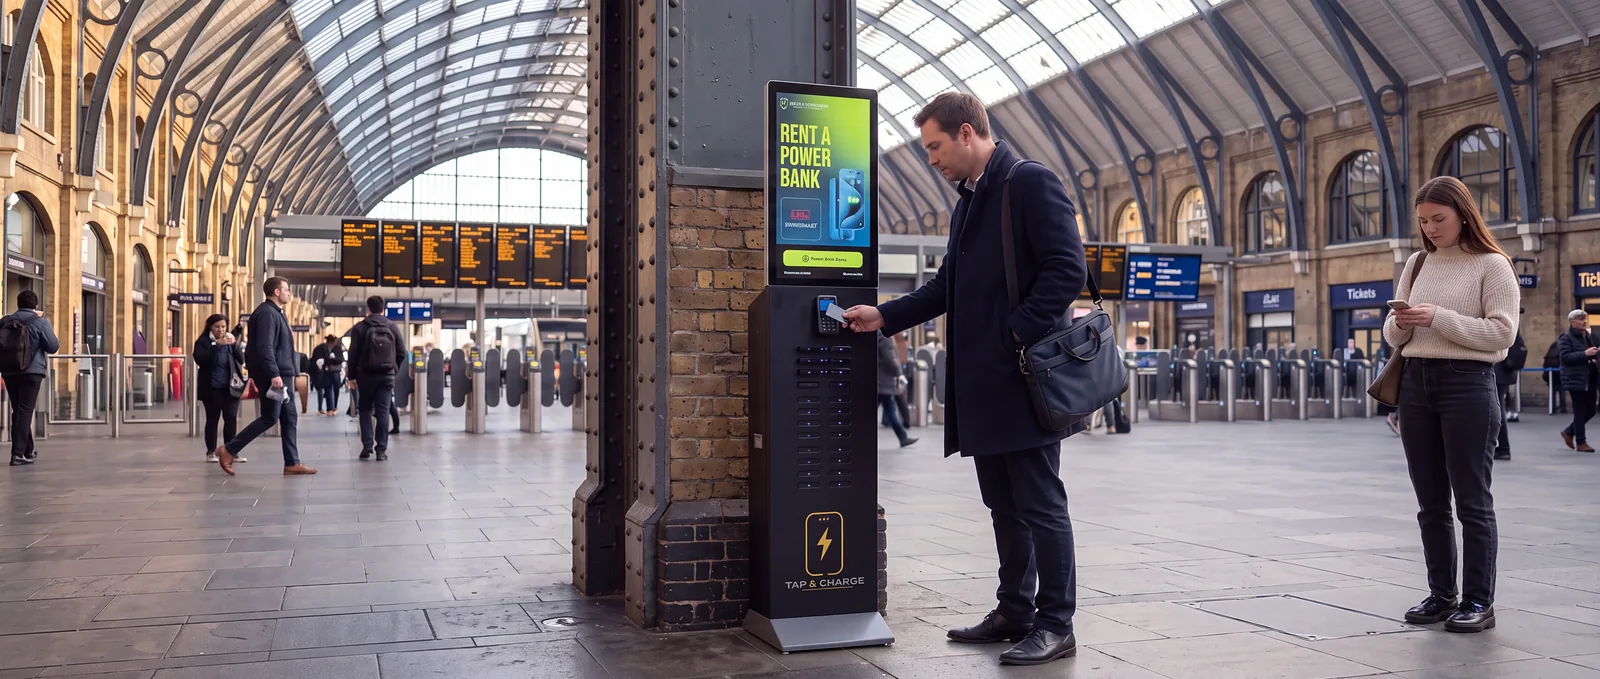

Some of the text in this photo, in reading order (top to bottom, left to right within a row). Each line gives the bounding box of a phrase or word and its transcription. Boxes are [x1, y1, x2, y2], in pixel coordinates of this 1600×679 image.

[781, 123, 831, 145] RENT A
[781, 145, 831, 167] POWER
[781, 167, 820, 188] BANK
[1347, 288, 1376, 300] Tickets
[785, 577, 865, 589] TAP & CHARGE
